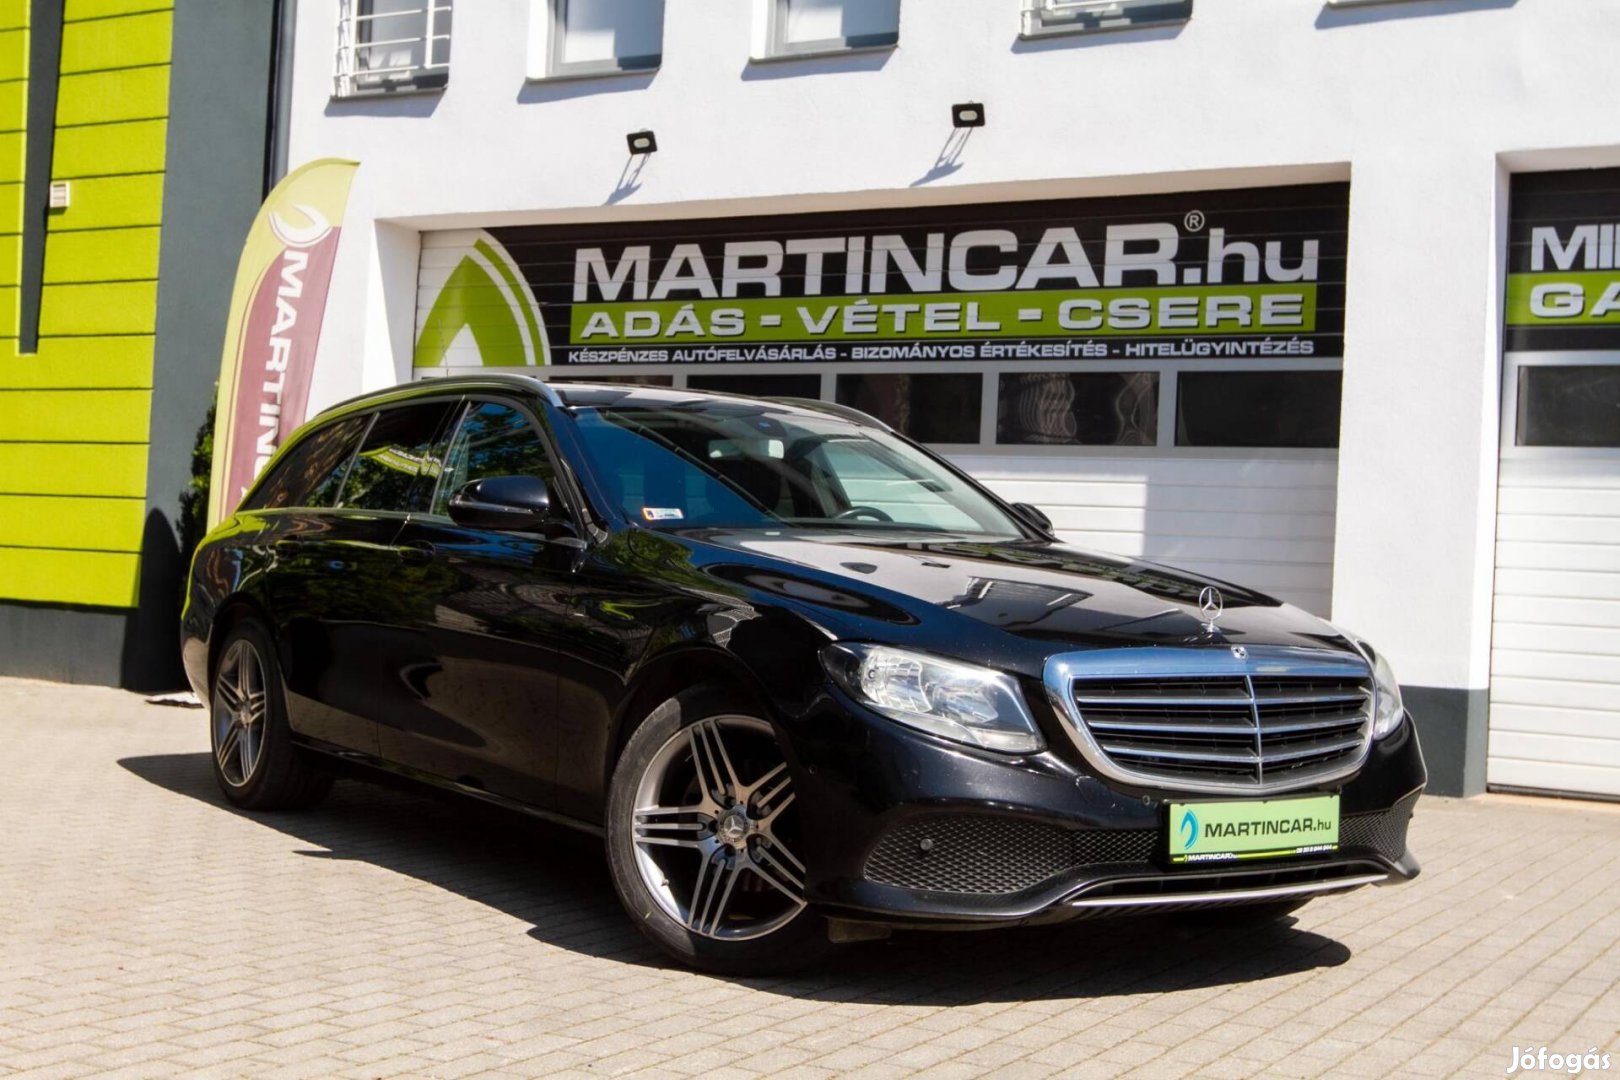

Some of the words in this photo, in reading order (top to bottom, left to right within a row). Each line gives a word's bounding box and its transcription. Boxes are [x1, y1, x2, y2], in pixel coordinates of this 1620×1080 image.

[1531, 223, 1620, 271] MI
[580, 303, 746, 339] ADÁS
[796, 298, 1001, 335] VÉTEL
[1058, 293, 1303, 331] CSERE
[568, 347, 668, 363] KÉSZPÉNZES
[672, 344, 836, 362] AUTÓFELVÁSÁRLÁS
[851, 343, 975, 360] BIZOMÁNYOS
[980, 339, 1107, 358] ÉRTÉKESÍTÉS
[1125, 337, 1314, 357] HITELÜGYINTÉZÉS
[1204, 818, 1332, 838] MARTINCAR.hu
